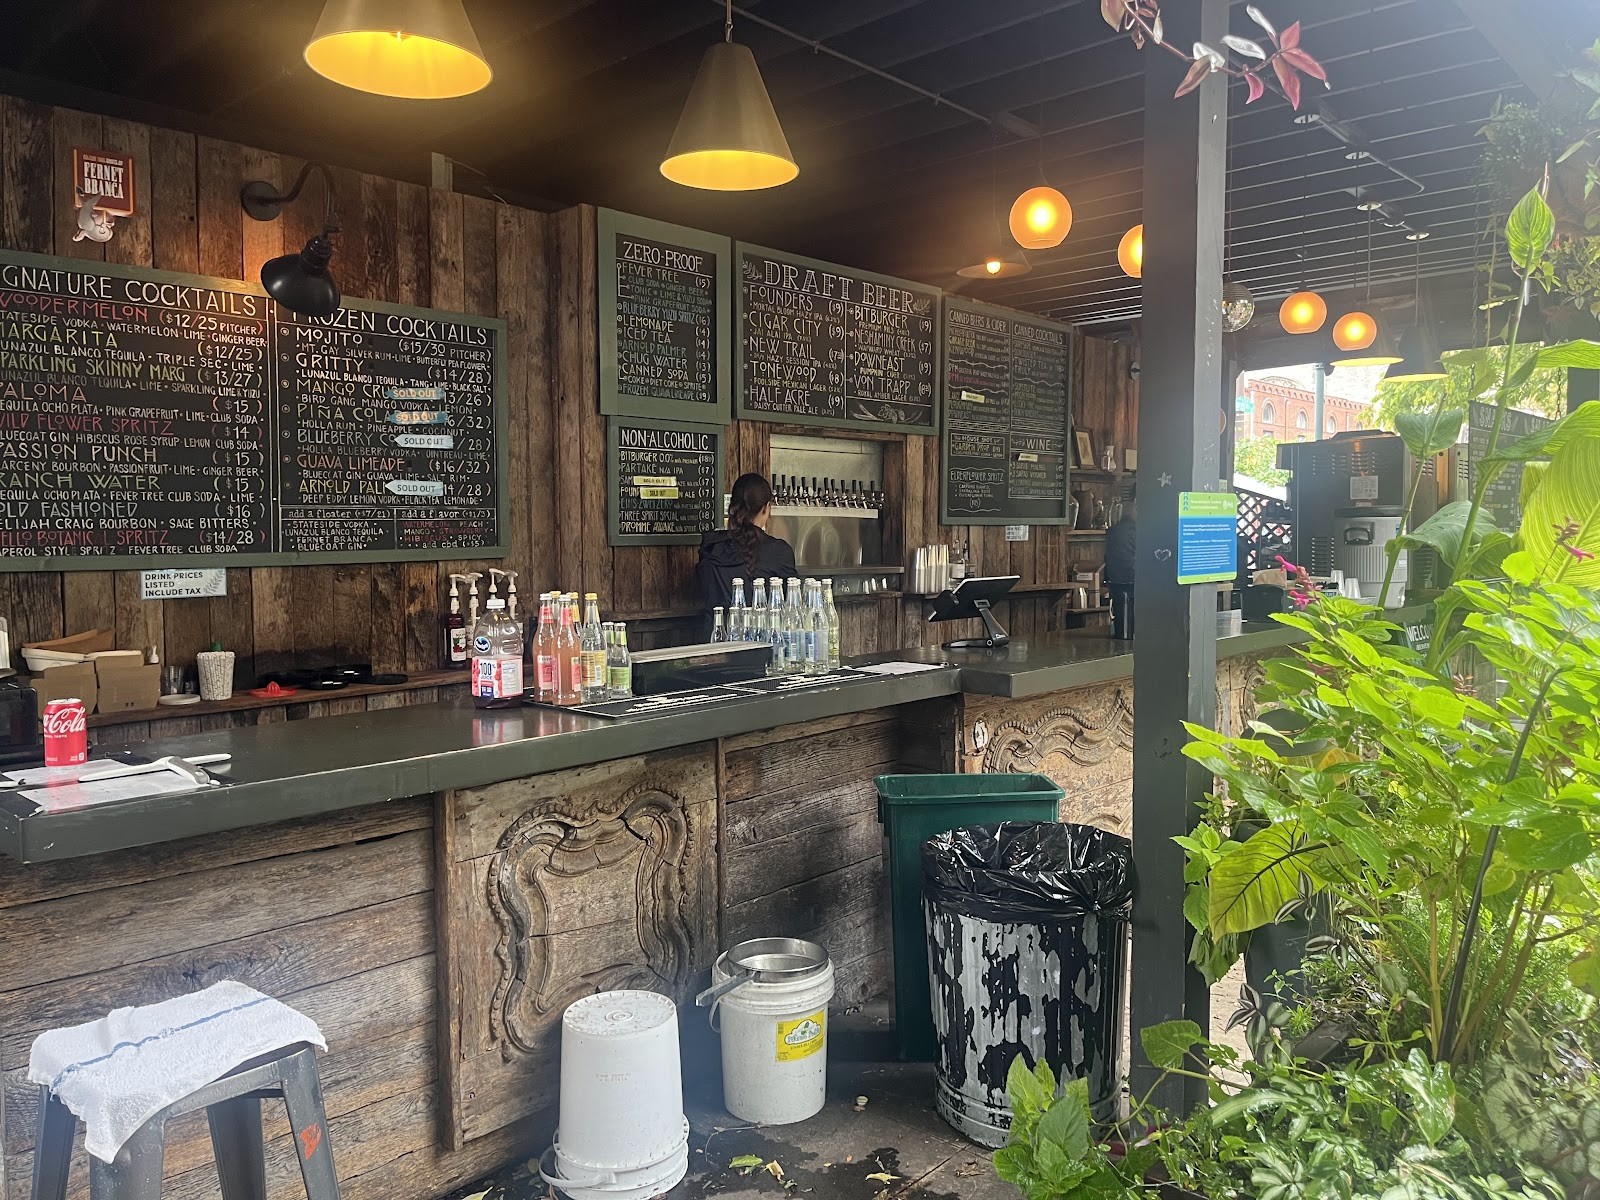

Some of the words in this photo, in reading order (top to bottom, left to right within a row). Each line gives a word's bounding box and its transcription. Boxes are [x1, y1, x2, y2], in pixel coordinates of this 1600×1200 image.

[84, 161, 124, 183] FERNET
[84, 178, 124, 199] BRANCA
[623, 241, 704, 273] ZERO-PROOF
[622, 262, 653, 279] FEVER
[655, 268, 679, 284] TREE
[763, 260, 854, 301] DRAFT
[861, 281, 915, 314] BEER
[125, 280, 256, 316] COCKTAILS
[749, 284, 813, 312] FOUNDERS
[622, 314, 674, 333] LEMONADE
[749, 310, 789, 333] CIGAR
[793, 318, 822, 337] CITY
[854, 305, 908, 330] BITBURGER
[63, 317, 98, 329] VODKA
[106, 321, 179, 338] WATERMELON
[183, 329, 206, 340] LIME
[211, 332, 244, 345] GINGER
[246, 336, 267, 348] BEER
[296, 326, 363, 348] MOJITO
[387, 315, 487, 346] COCKTAILS
[623, 326, 648, 340] ICED
[651, 330, 672, 345] TEA
[345, 347, 373, 359] SILVER
[621, 340, 656, 354] ARNOLD
[749, 335, 780, 354] NEW
[783, 340, 816, 361] TRAIL
[54, 344, 101, 358] BLANCO
[104, 348, 145, 362] TEQUILA
[156, 352, 196, 367] TRIPLE
[200, 357, 222, 369] SEC
[231, 361, 255, 373] LIME
[296, 352, 364, 373] GRITTY
[622, 350, 650, 366] CHUG
[653, 354, 688, 370] WATER
[854, 350, 906, 373] DOWNEAST
[86, 358, 142, 379] SKINNY
[150, 364, 185, 382] MARG
[301, 368, 342, 381] LUNAZUL
[621, 362, 663, 378] CANNED
[667, 368, 689, 381] SODA
[749, 360, 817, 383] TONEWOOD
[140, 381, 162, 392] LIME
[171, 382, 216, 395] SPARKLING
[296, 378, 355, 397] MANGO
[392, 388, 417, 399] SOLD
[418, 389, 437, 398] OUT
[853, 374, 875, 391] VON
[878, 377, 912, 395] TRAPP
[301, 393, 326, 404] BIRD
[330, 395, 356, 407] GANG
[361, 398, 397, 410] MANGO
[400, 401, 430, 411] VODKA
[749, 384, 782, 404] HALF
[784, 388, 811, 407] ACRE
[41, 401, 68, 413] OCHO
[71, 403, 99, 416] PLATA
[106, 405, 127, 417] PINK
[128, 406, 179, 420] GRAPEFRUIT
[185, 410, 206, 422] LIME
[210, 412, 232, 424] CLUB
[235, 414, 258, 425] SODA
[297, 402, 345, 421] PIÑA
[37, 413, 103, 432] FLOWER
[112, 417, 174, 436] SPRITZ
[367, 423, 413, 434] PINEAPPLE
[49, 431, 70, 443] GIN
[76, 433, 121, 445] HIBISCUS
[124, 435, 148, 446] ROSE
[150, 436, 180, 447] SYRUP
[184, 438, 211, 448] LEMON
[215, 440, 235, 450] CLUB
[236, 440, 259, 451] SODA
[297, 428, 374, 447] BLUEBERRY
[404, 437, 425, 445] SOLD
[621, 429, 709, 451] NON-ALCOHOLIC
[1026, 438, 1052, 452] WINE
[92, 445, 157, 463] PUNCH
[337, 445, 388, 457] BLUEBERRY
[620, 450, 658, 463] BITBURGER
[51, 461, 101, 473] BOURBON
[109, 463, 169, 475] PASSIONFRUIT
[173, 464, 196, 476] LIME
[202, 466, 233, 477] GINGER
[235, 466, 260, 477] BEER
[296, 453, 343, 470] GUAVA
[348, 456, 406, 472] LIMEADE
[620, 462, 657, 474] PARTAKE
[87, 474, 160, 490] WATER
[345, 470, 362, 480] GIN
[366, 471, 395, 481] GUAVA
[298, 479, 351, 494] ARNOLD
[397, 484, 418, 492] SOLD
[419, 485, 436, 493] OUT
[43, 490, 70, 501] OCHO
[110, 490, 139, 501] FEVER
[140, 491, 164, 502] TREE
[167, 491, 192, 502] CLUB
[193, 492, 221, 502] SODA
[230, 492, 255, 503] LIME
[40, 501, 138, 518] FASHIONED
[55, 518, 94, 530] CRAIG
[99, 518, 157, 530] BOURBON
[169, 518, 195, 529] SAGE
[199, 517, 250, 529] BITTERS
[292, 520, 341, 529] STATESIDE
[116, 530, 170, 546] SPRITZ
[296, 536, 330, 544] FERNET
[333, 535, 373, 543] BRANCA
[297, 542, 345, 551] BLUECOAT
[347, 542, 363, 551] GIN
[128, 546, 159, 555] FEVER
[160, 545, 184, 554] TREE
[187, 545, 212, 554] CLUB
[214, 544, 239, 553] SODA
[145, 581, 175, 589] LISTED
[173, 571, 203, 580] PRICES
[145, 588, 183, 597] INCLUDE
[185, 587, 202, 596] TAX
